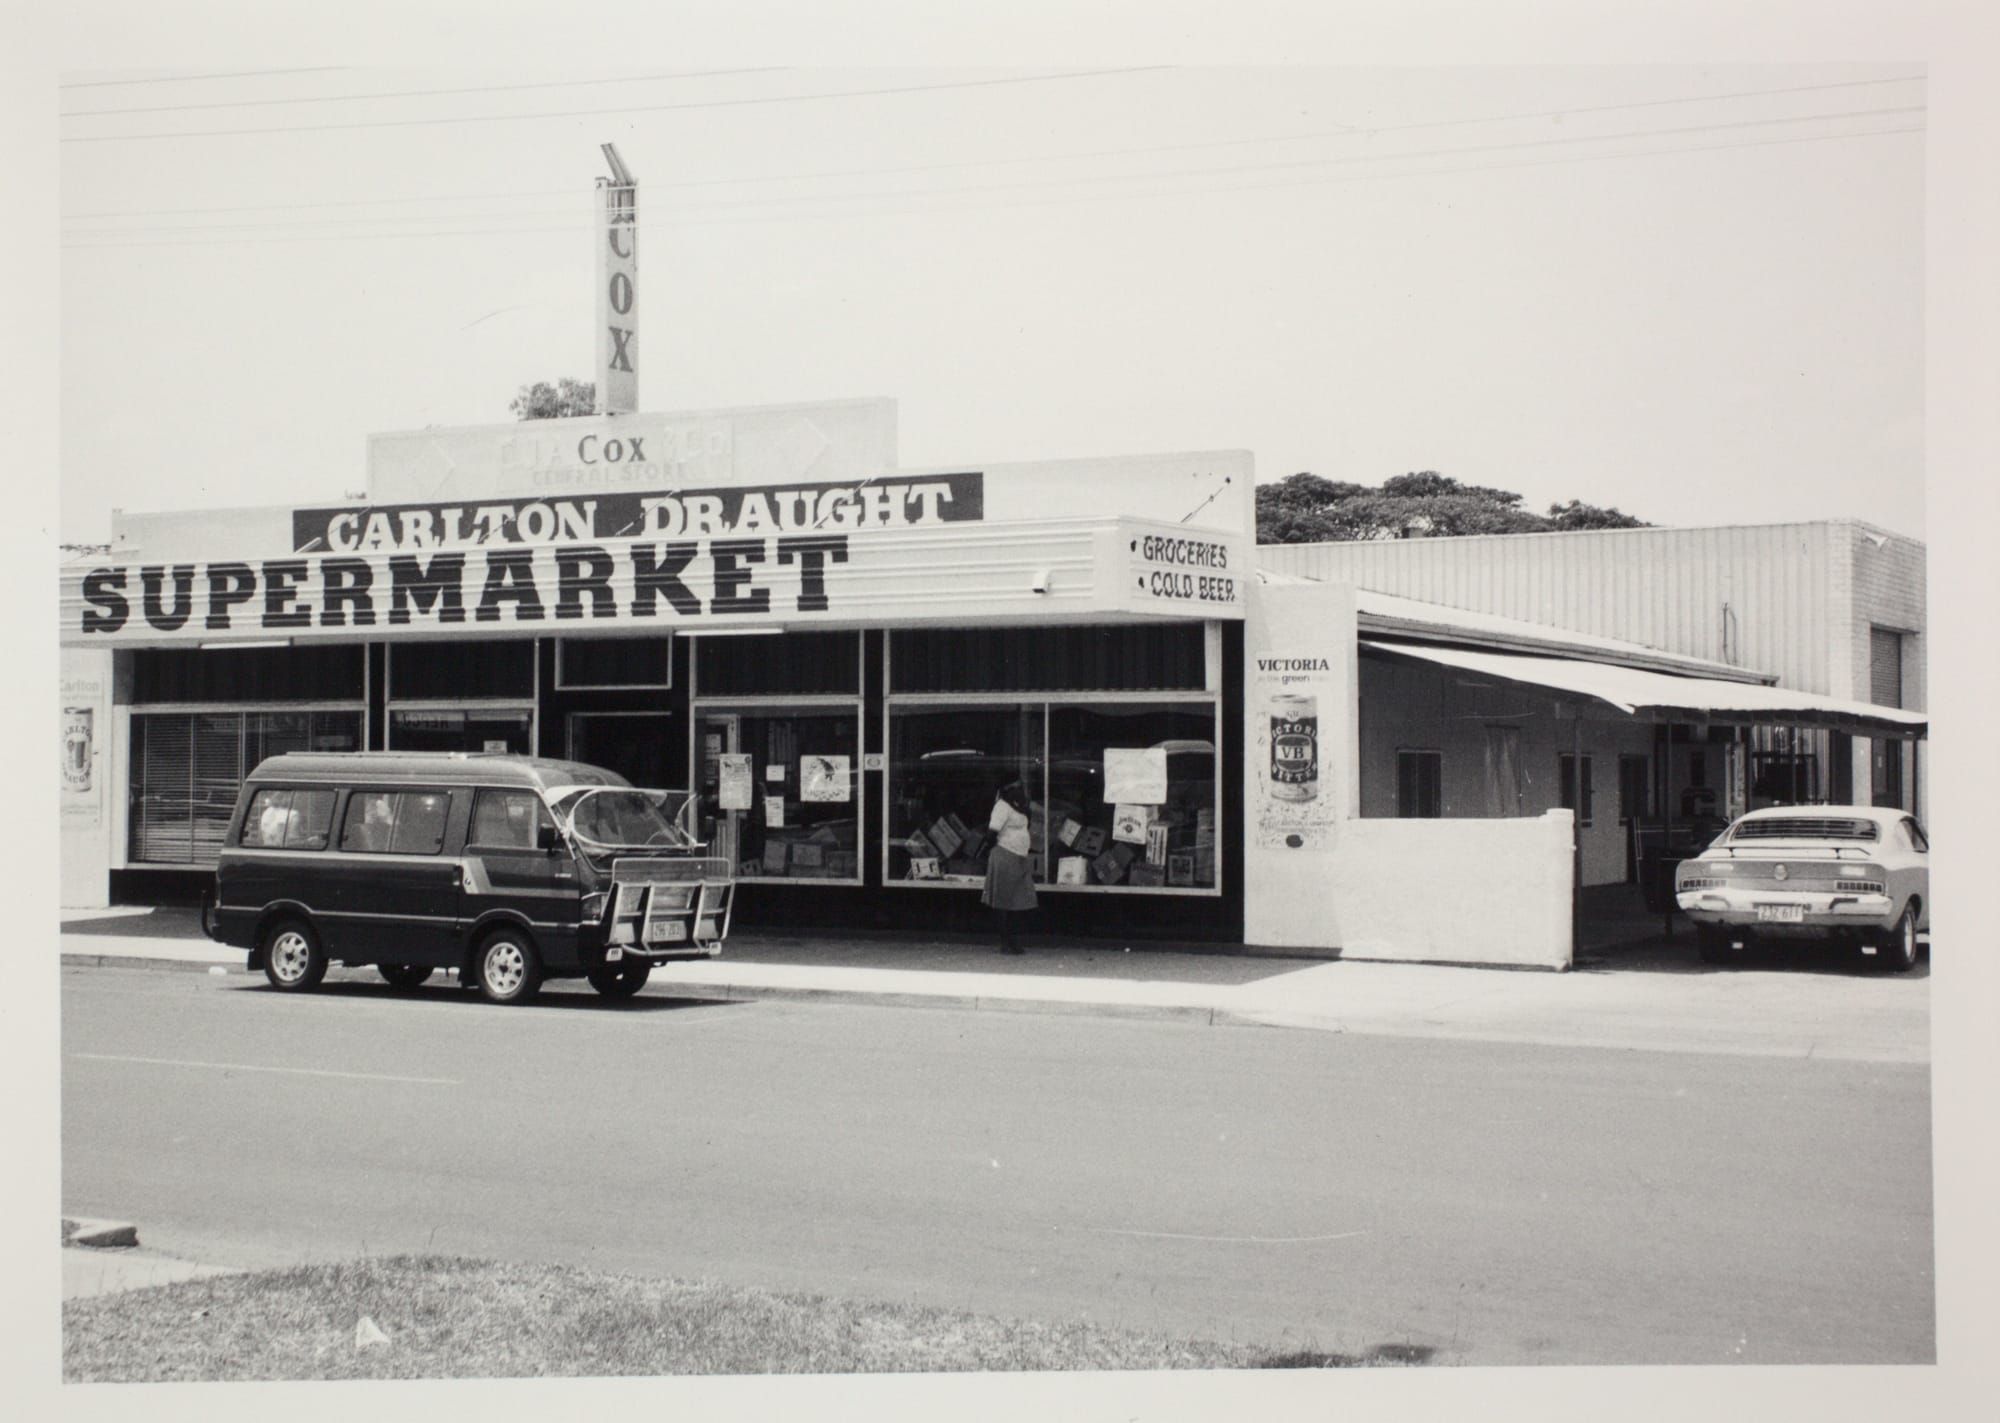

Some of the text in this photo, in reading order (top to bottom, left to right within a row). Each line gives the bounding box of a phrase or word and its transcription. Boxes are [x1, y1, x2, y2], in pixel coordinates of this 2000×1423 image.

[608, 217, 634, 372] COX
[327, 482, 952, 552] CARLTON DRAUGHT
[1143, 536, 1228, 568] GROCERIES
[82, 534, 848, 634] SUPERMARKET
[1151, 570, 1193, 598] COLD
[1257, 658, 1330, 672] VICTORIA
[1282, 674, 1311, 686] green
[1282, 746, 1304, 760] VB
